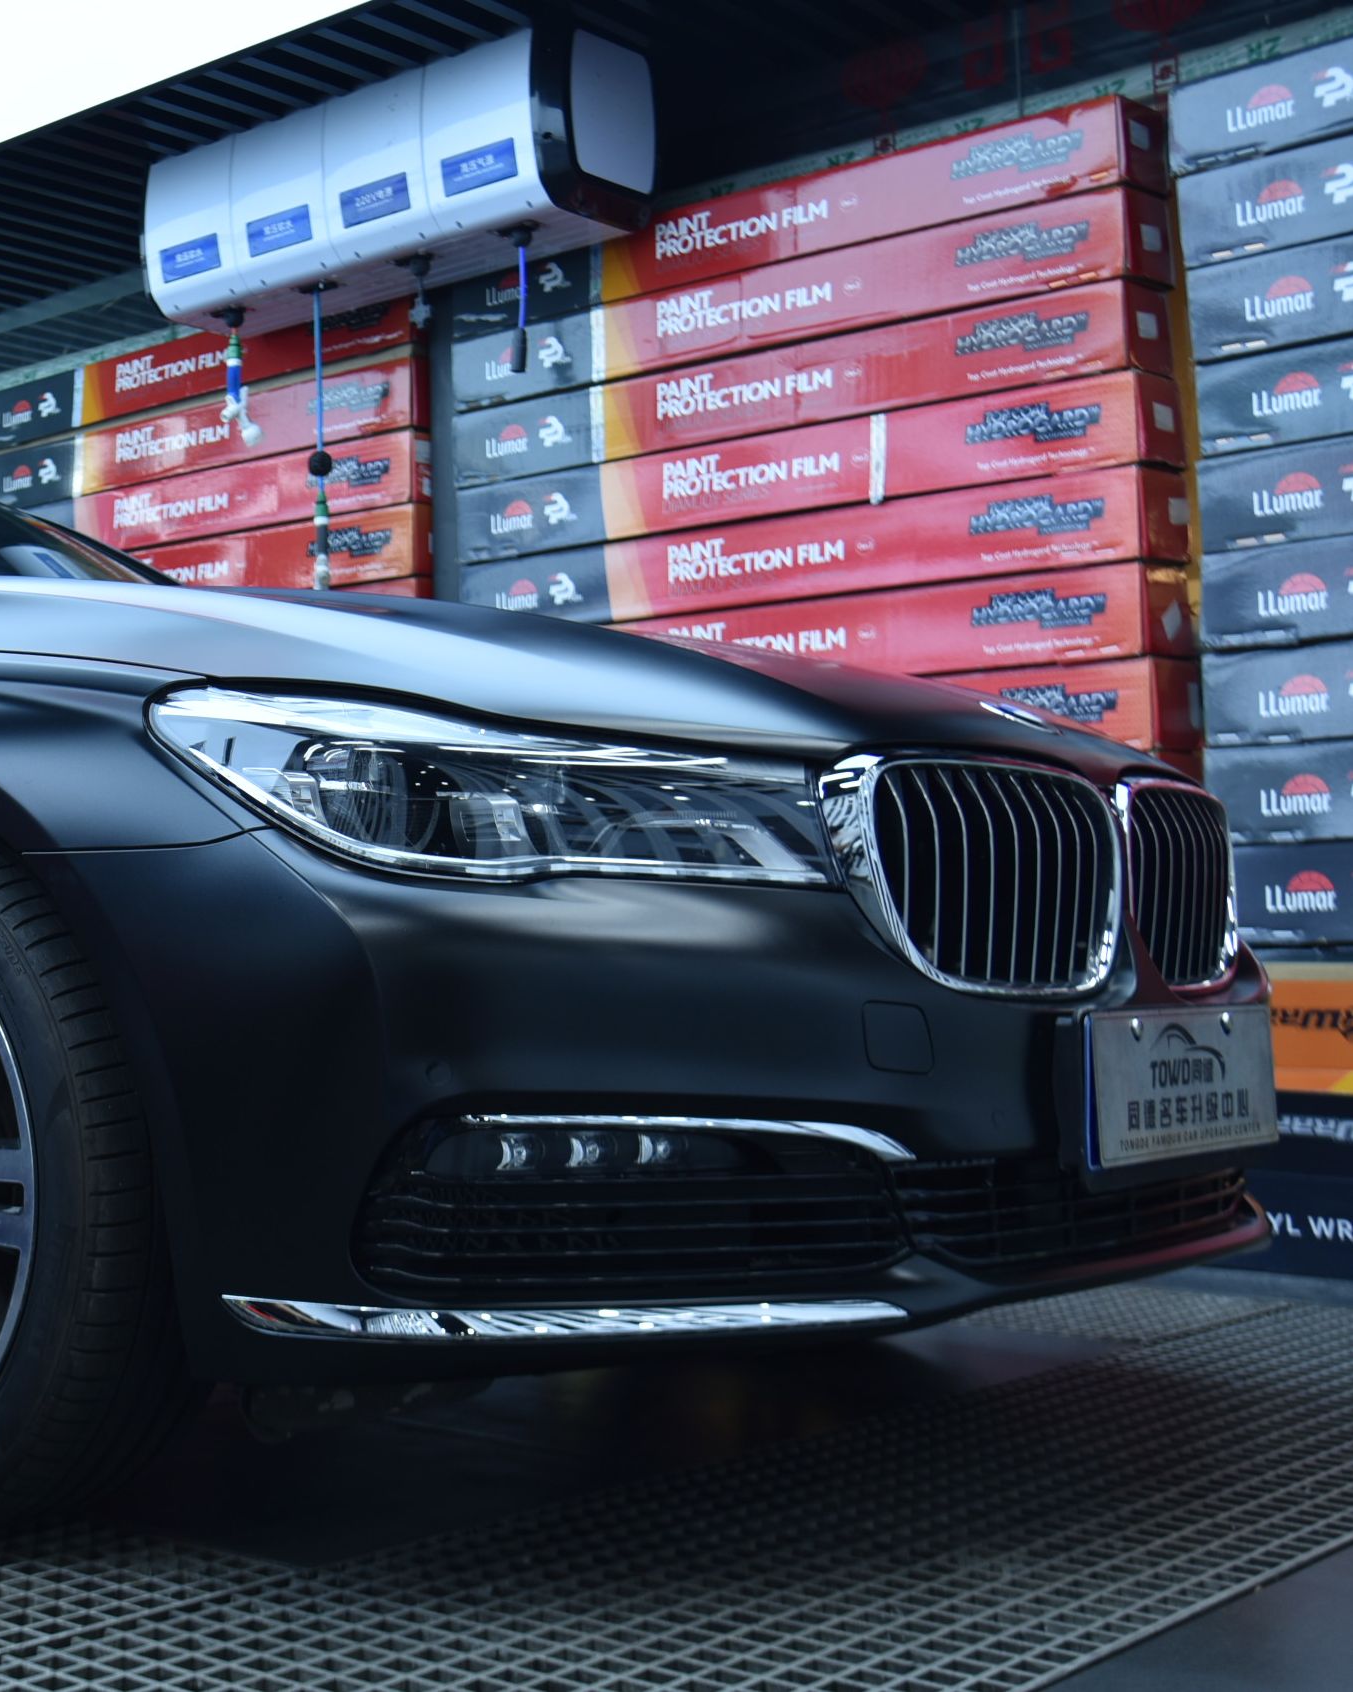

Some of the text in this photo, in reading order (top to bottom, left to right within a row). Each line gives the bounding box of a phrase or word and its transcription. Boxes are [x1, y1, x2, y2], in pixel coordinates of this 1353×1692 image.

[1226, 99, 1295, 133] LLumar
[1236, 195, 1305, 227] LLumar
[655, 211, 711, 242] PAINT
[655, 199, 828, 260] PROTECTION FILM
[656, 289, 713, 319] PAINT
[656, 293, 781, 338] PROTECTION
[785, 281, 833, 310] FILM
[1244, 291, 1315, 322] LLumar
[115, 354, 154, 378] PAINT
[115, 349, 228, 393] PROTECTION FILM
[656, 372, 714, 401] PAINT
[656, 378, 781, 420] PROTECTION
[785, 367, 833, 396] FILM
[1251, 388, 1322, 417] LLumar
[115, 426, 155, 449] PAINT
[115, 423, 230, 463] PROTECTION FILM
[485, 437, 528, 459] LLumar
[662, 453, 721, 481] PAINT
[662, 451, 840, 500] PROTECTION FILM
[113, 493, 228, 529] PROTECTION FILM
[114, 493, 152, 516] PAINT
[1252, 488, 1324, 517] LLumar
[490, 513, 534, 535] LLumar
[667, 537, 725, 564] PAINT
[668, 538, 845, 584] PROTECTION FILM
[197, 561, 229, 581] FILM
[1257, 590, 1329, 618] LLumar
[798, 627, 846, 653] FILM
[1258, 691, 1330, 718] LLumar
[1260, 788, 1333, 817] LLumar
[1264, 884, 1338, 913] LLumar
